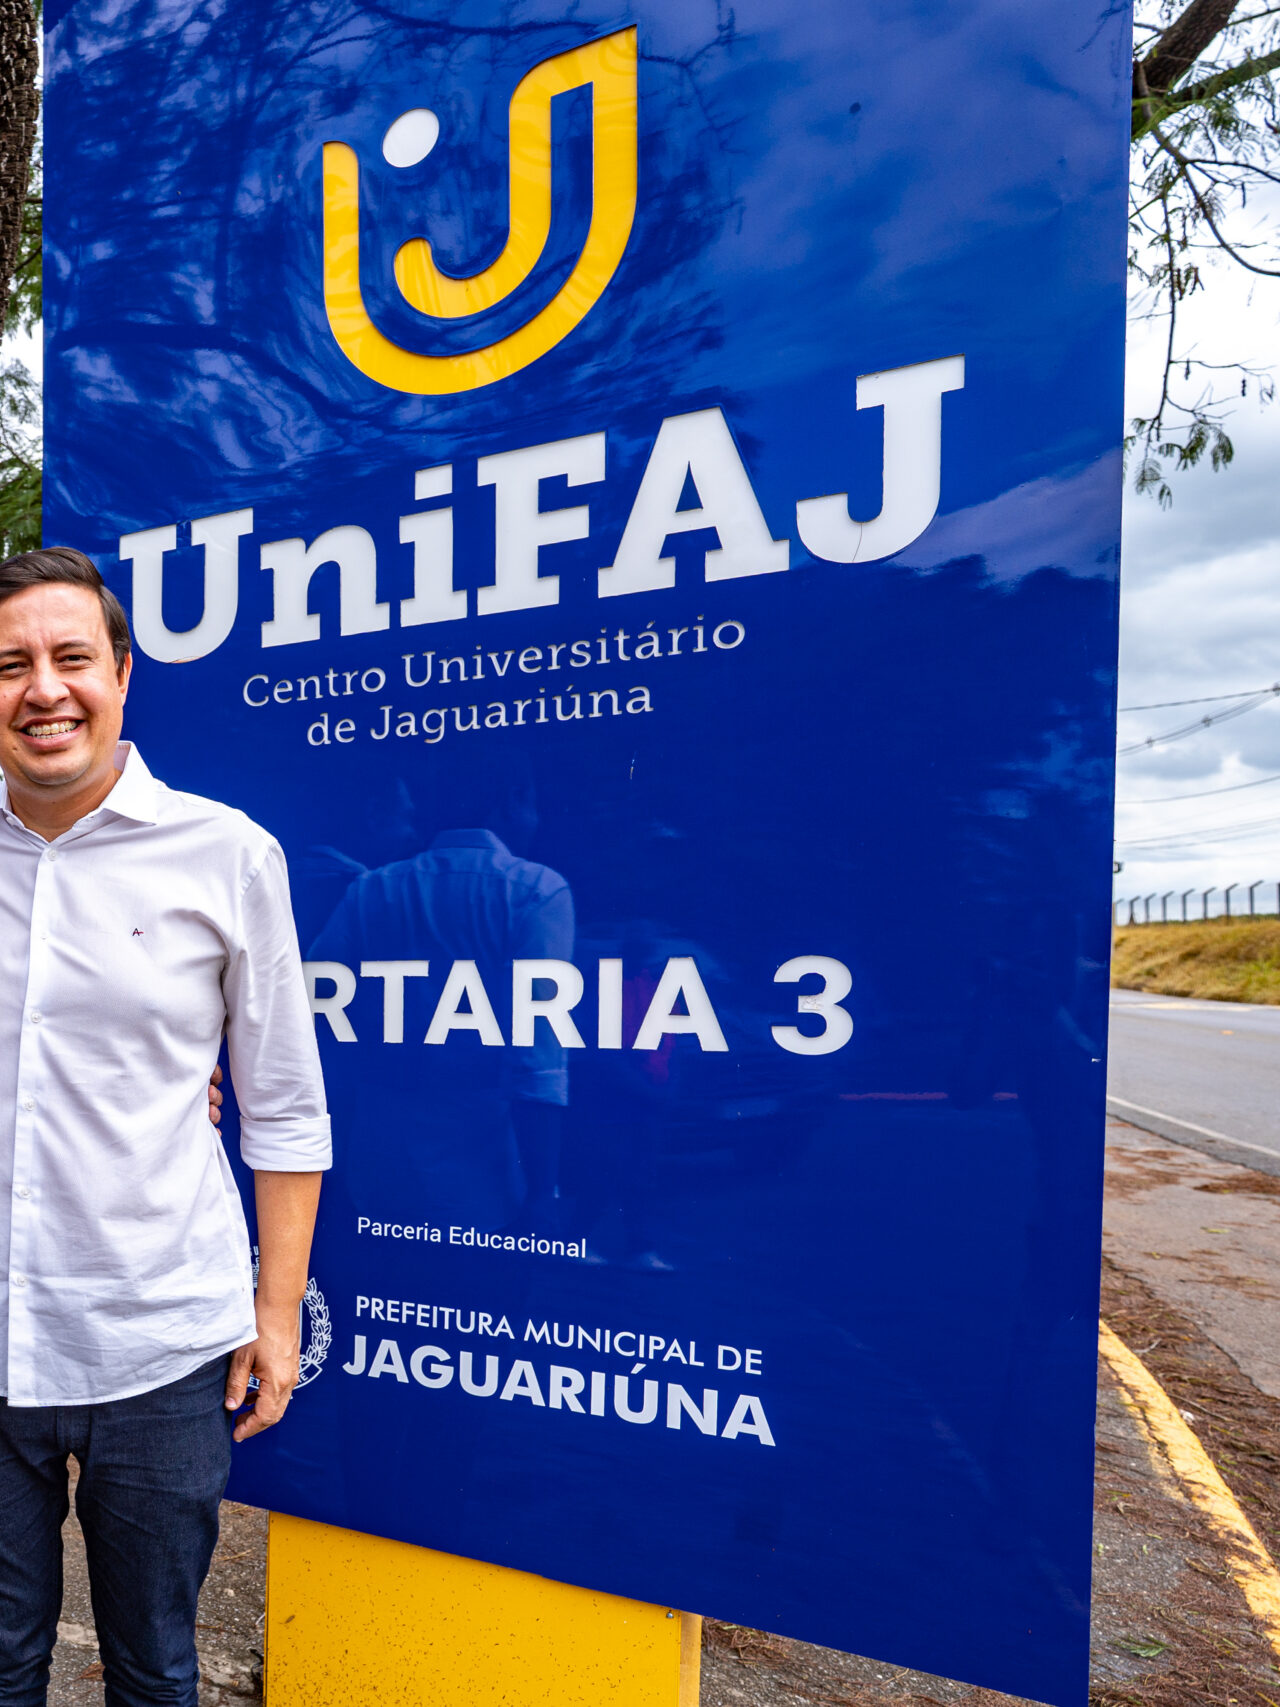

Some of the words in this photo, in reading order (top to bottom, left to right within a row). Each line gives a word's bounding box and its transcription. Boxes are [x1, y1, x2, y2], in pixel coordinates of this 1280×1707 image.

[119, 354, 965, 665] UniFAJ
[242, 668, 386, 707] Centro
[401, 614, 746, 688] Universitário
[306, 712, 356, 746] de
[369, 679, 654, 744] Jaguariúna
[302, 956, 729, 1052] RTARIA
[771, 955, 854, 1056] 3
[357, 1216, 442, 1243] Parceria
[449, 1225, 586, 1259] Educacional
[356, 1295, 516, 1340] PREFEITURA
[523, 1318, 705, 1368] MUNICIPAL
[717, 1344, 763, 1376] DE
[342, 1334, 776, 1447] JAGUARIÚNA
